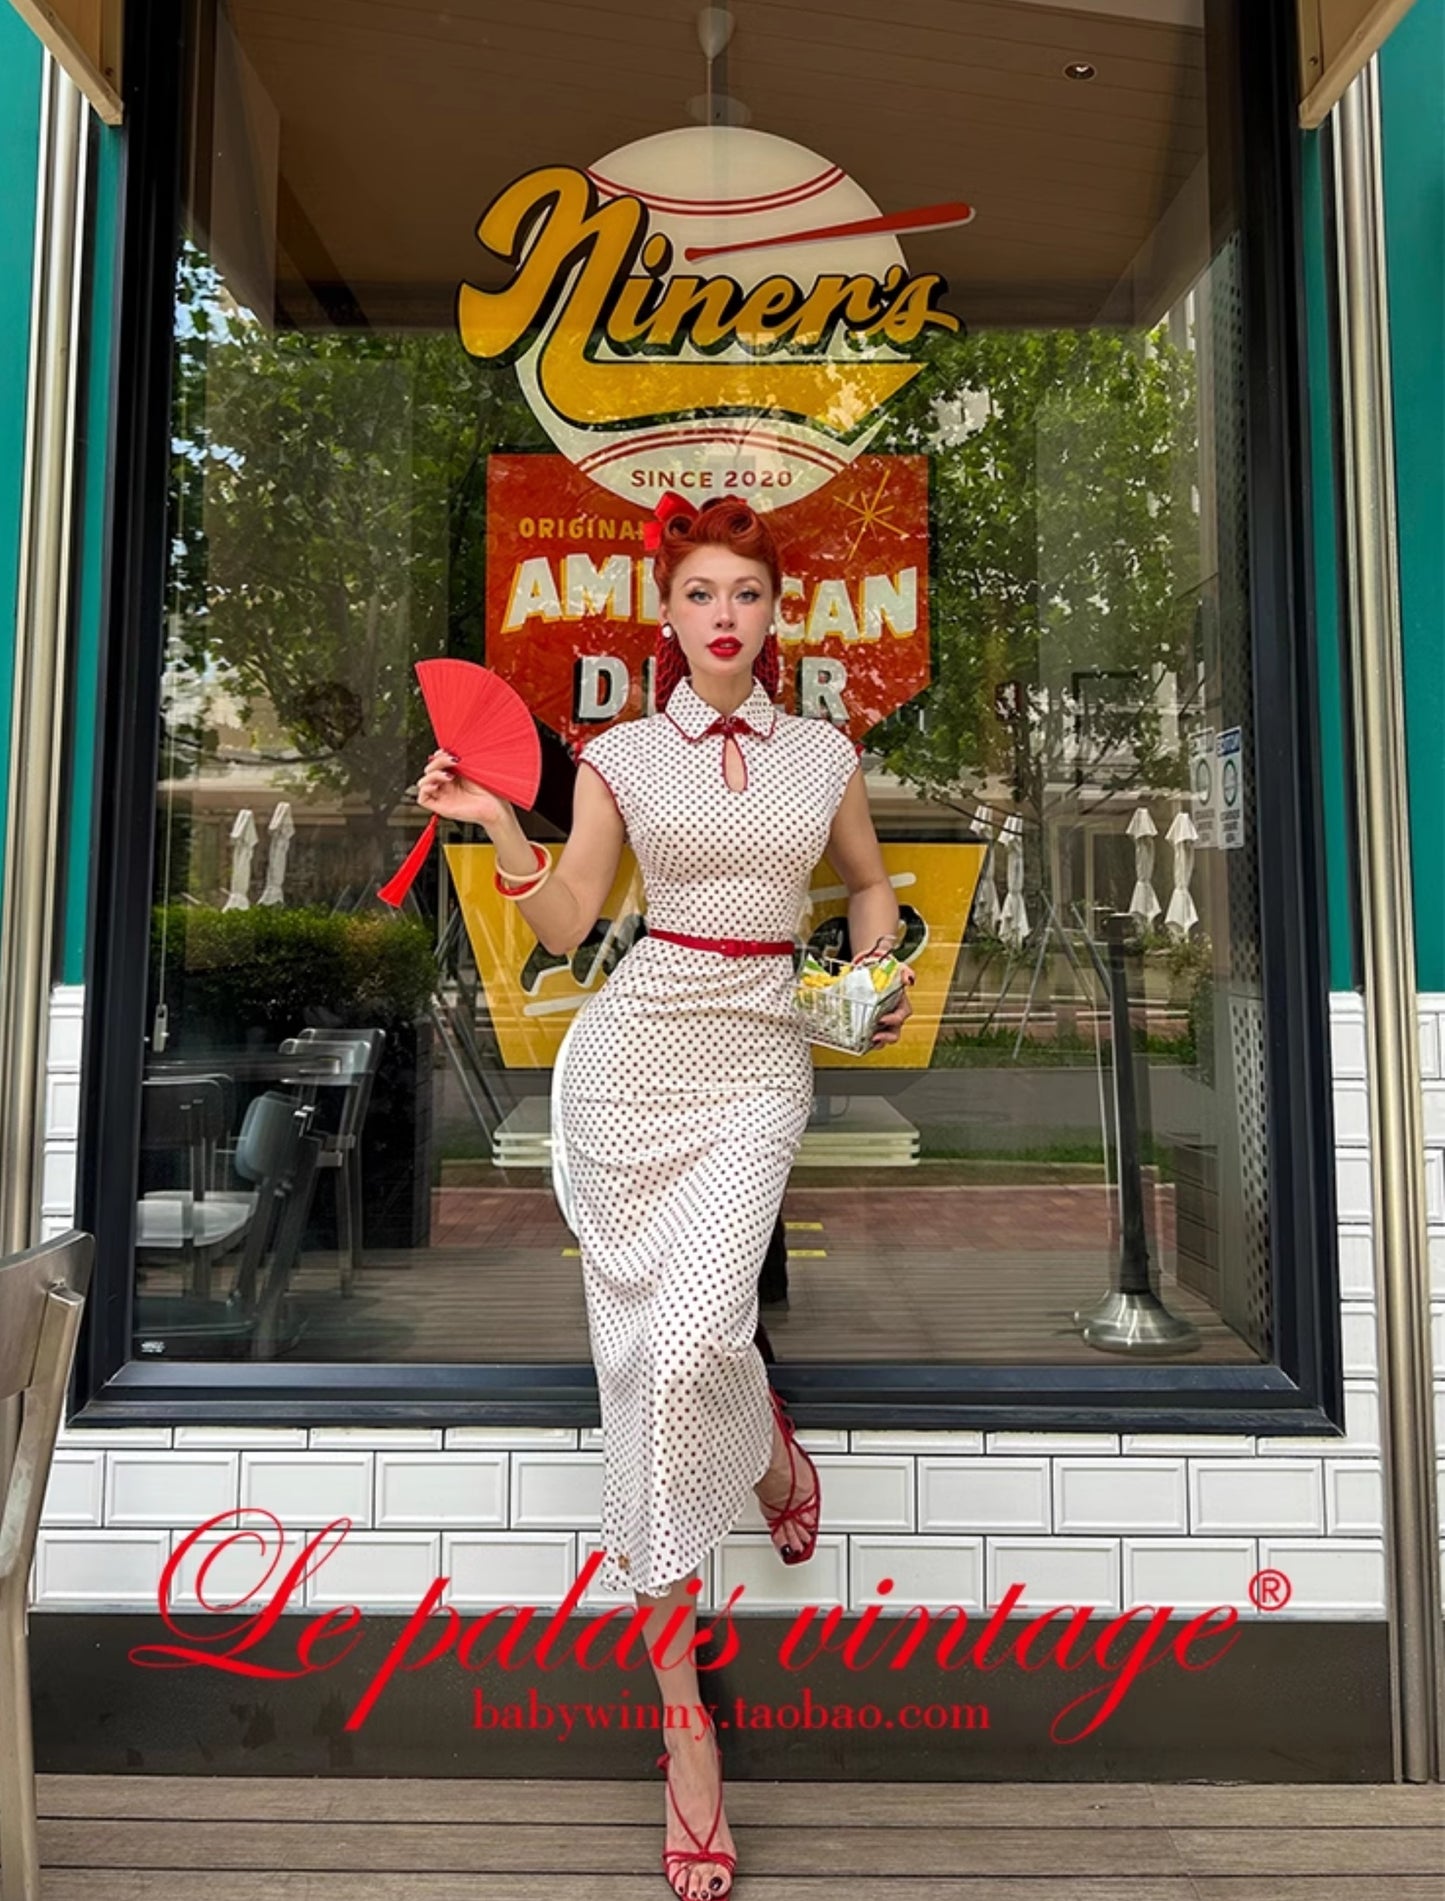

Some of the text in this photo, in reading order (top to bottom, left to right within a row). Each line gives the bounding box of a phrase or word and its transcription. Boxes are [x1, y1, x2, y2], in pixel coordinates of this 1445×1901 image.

[457, 164, 967, 428] Niner's
[631, 469, 794, 489] SINCE 2020
